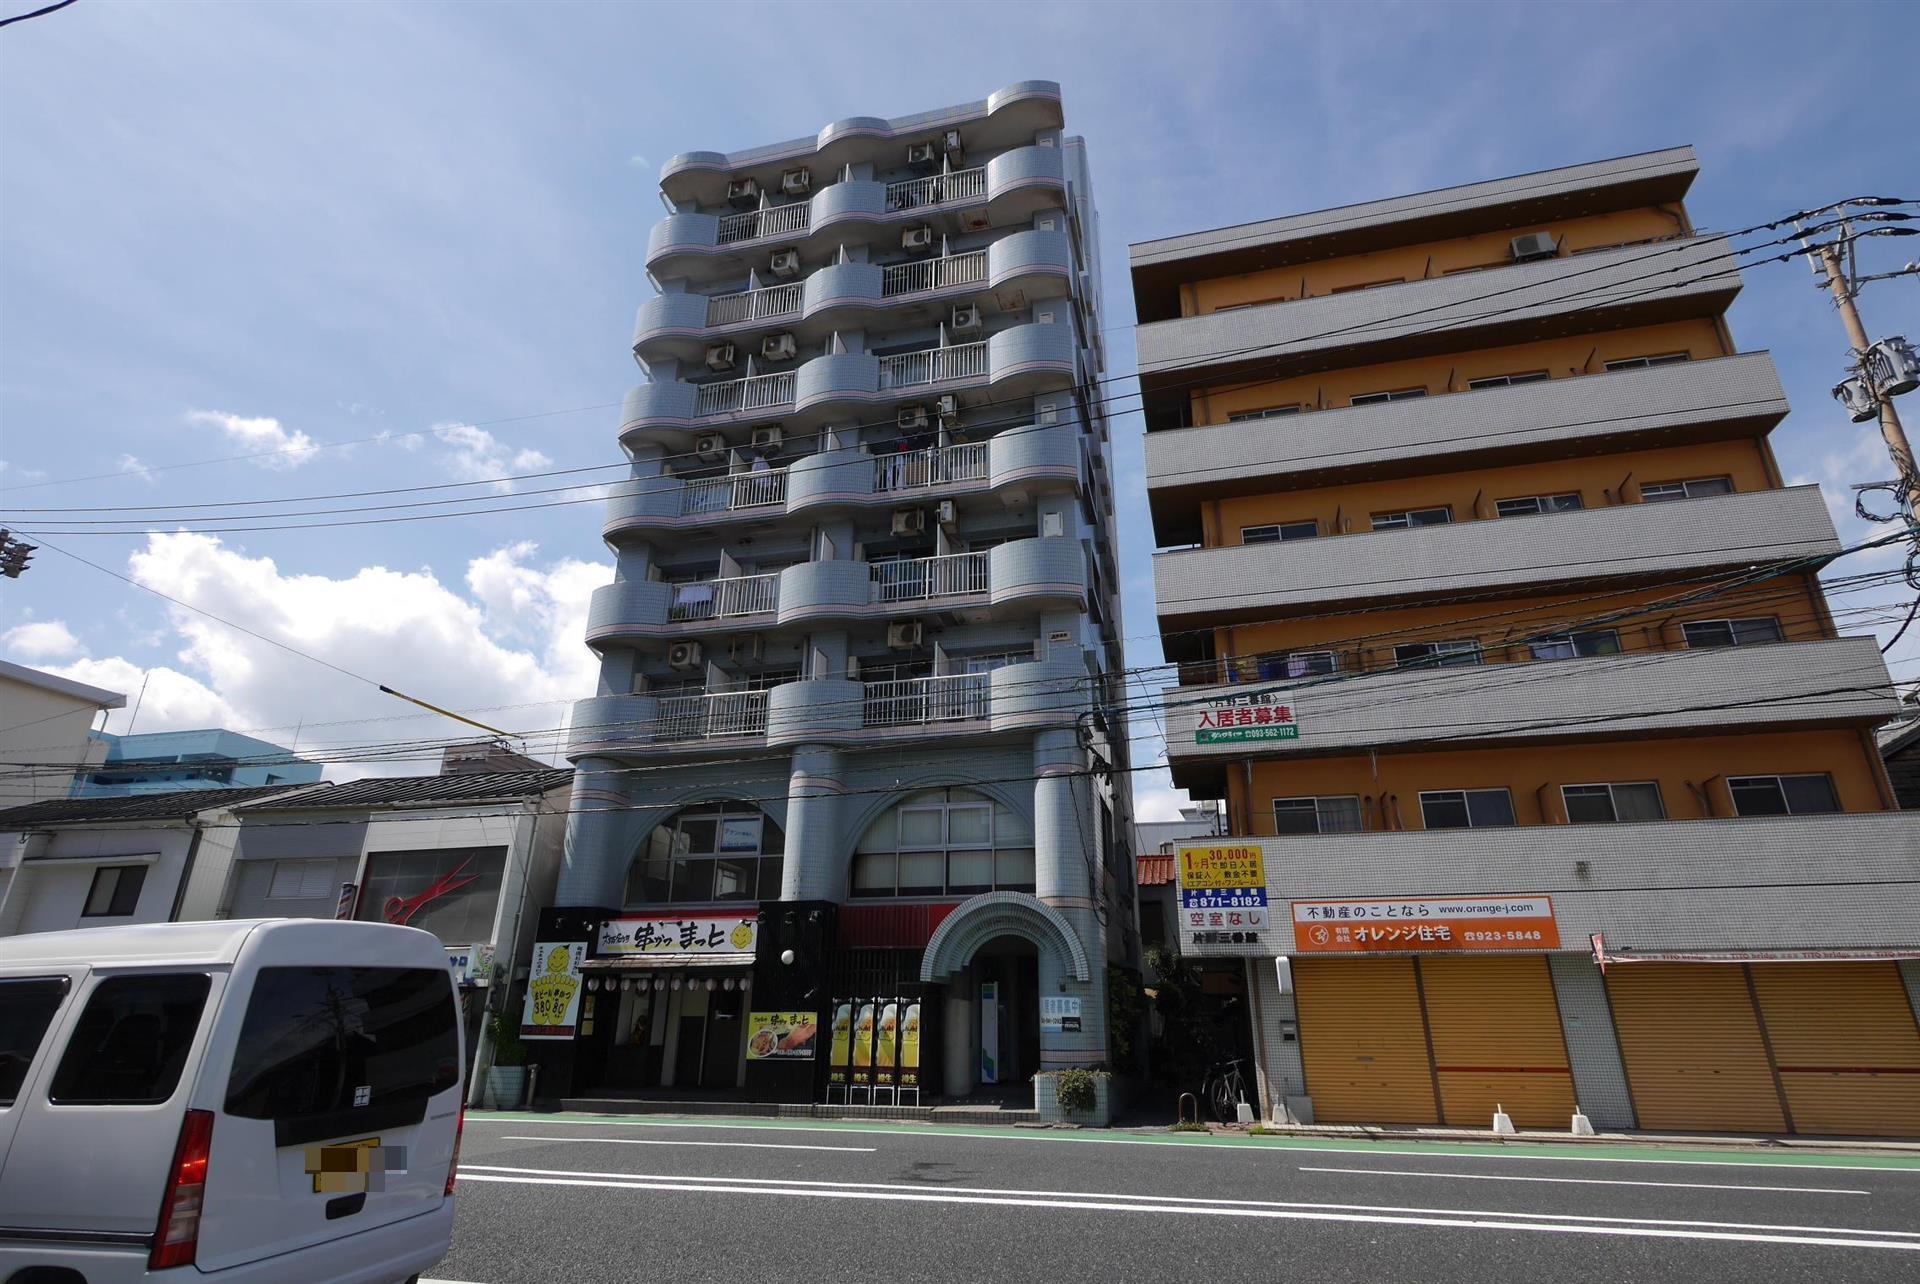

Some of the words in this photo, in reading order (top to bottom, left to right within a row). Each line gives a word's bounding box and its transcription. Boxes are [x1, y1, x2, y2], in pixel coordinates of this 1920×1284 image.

[1198, 705, 1293, 728] 入居者募集
[1251, 727, 1295, 738] 093-562-1172
[1210, 860, 1257, 869] で即日入居
[1190, 888, 1258, 897] 片野三番館
[1199, 896, 1261, 907] 871-8182
[1190, 911, 1260, 926] 空室なし
[1307, 904, 1429, 919] 不動産のことなら
[1439, 903, 1534, 915] www.orange-j.com
[634, 922, 673, 951] 串かつ
[679, 920, 726, 950] まっと
[1354, 925, 1451, 942] オレンジ住宅
[1476, 930, 1542, 941] 923-5848
[535, 999, 550, 1014] 380
[552, 1002, 565, 1014] 80
